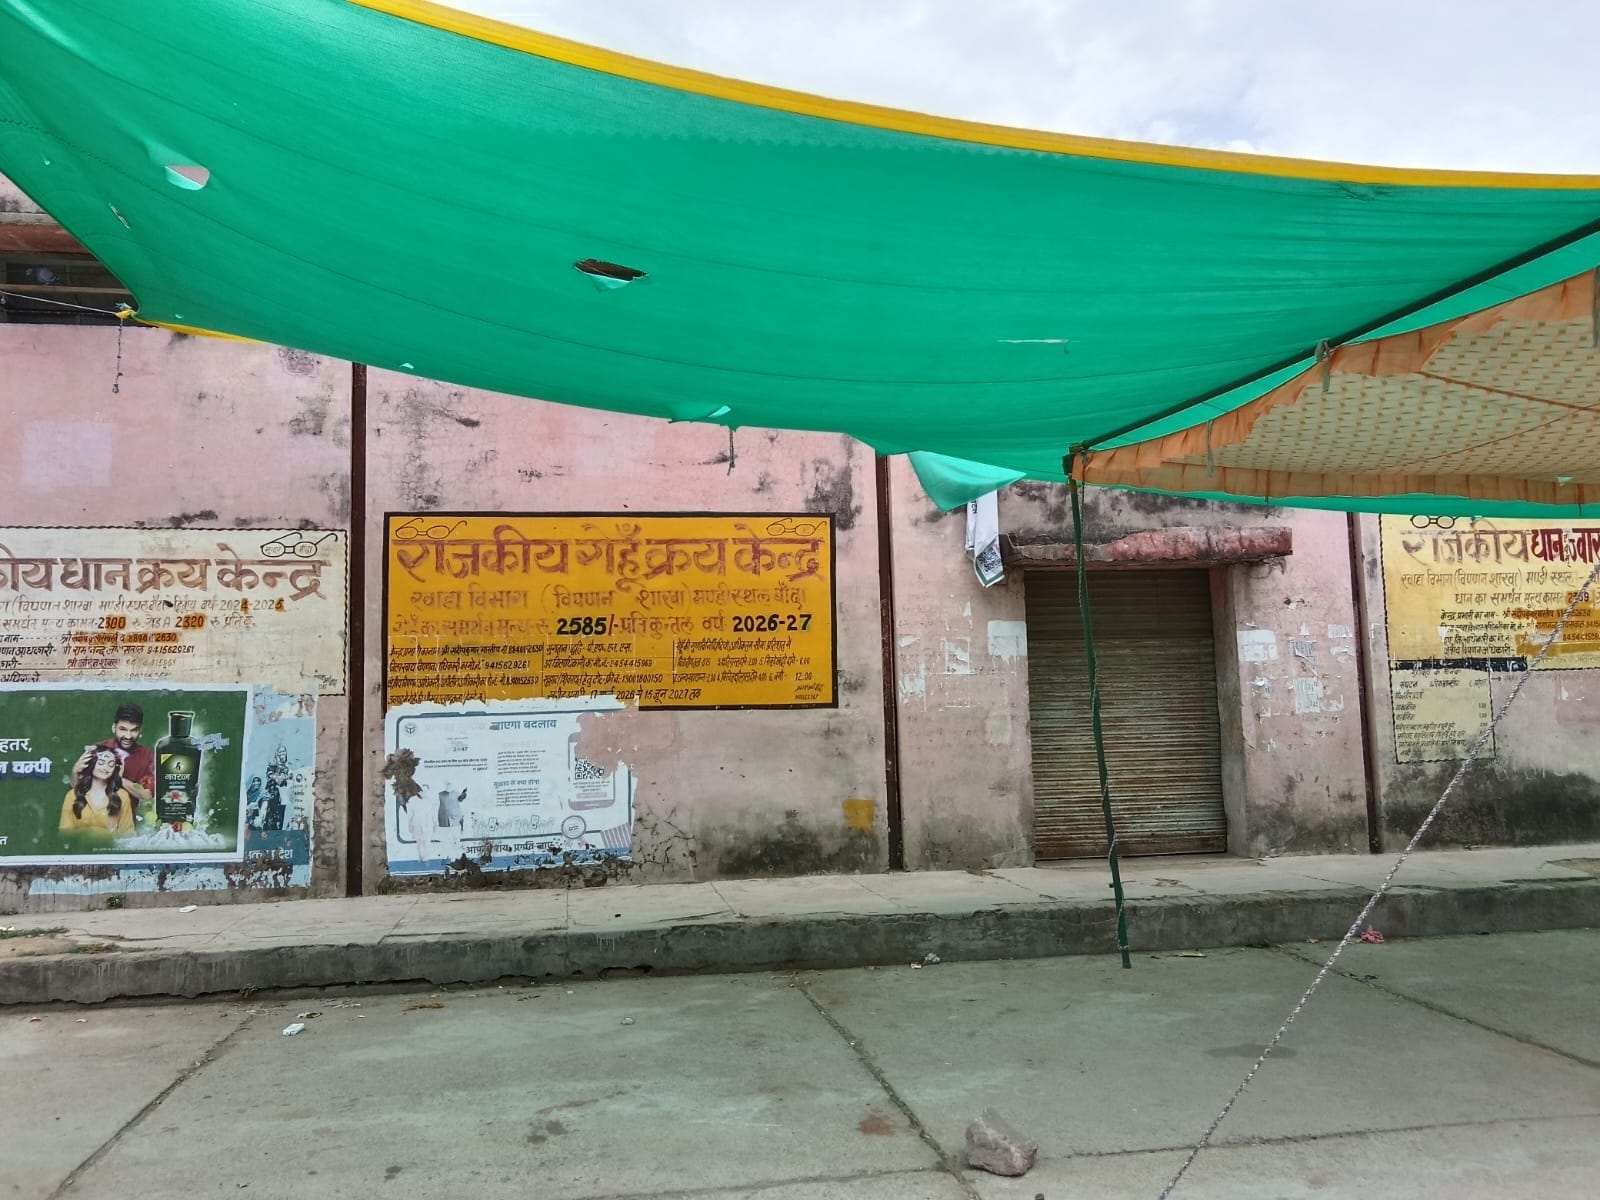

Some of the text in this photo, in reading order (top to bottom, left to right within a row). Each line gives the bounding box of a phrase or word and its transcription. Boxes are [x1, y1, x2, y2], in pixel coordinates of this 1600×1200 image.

[1401, 517, 1529, 566] राजकीय
[1531, 528, 1566, 562] धान
[392, 522, 825, 592] राजकीय गेहूँ क्रय केन्द्र
[60, 557, 133, 593] धान
[136, 557, 211, 595] क्रय
[216, 542, 332, 601] केन्द्र
[1455, 592, 1473, 605] धान
[1475, 592, 1486, 605] का
[98, 616, 127, 630] 2300
[175, 615, 205, 629] 2320
[731, 613, 812, 633] 2026-27
[485, 659, 530, 670] 9415629261
[615, 690, 635, 700] 2026
[668, 688, 689, 700] 2027
[523, 719, 557, 729] बदलाव
[12, 757, 52, 775] चम्पी
